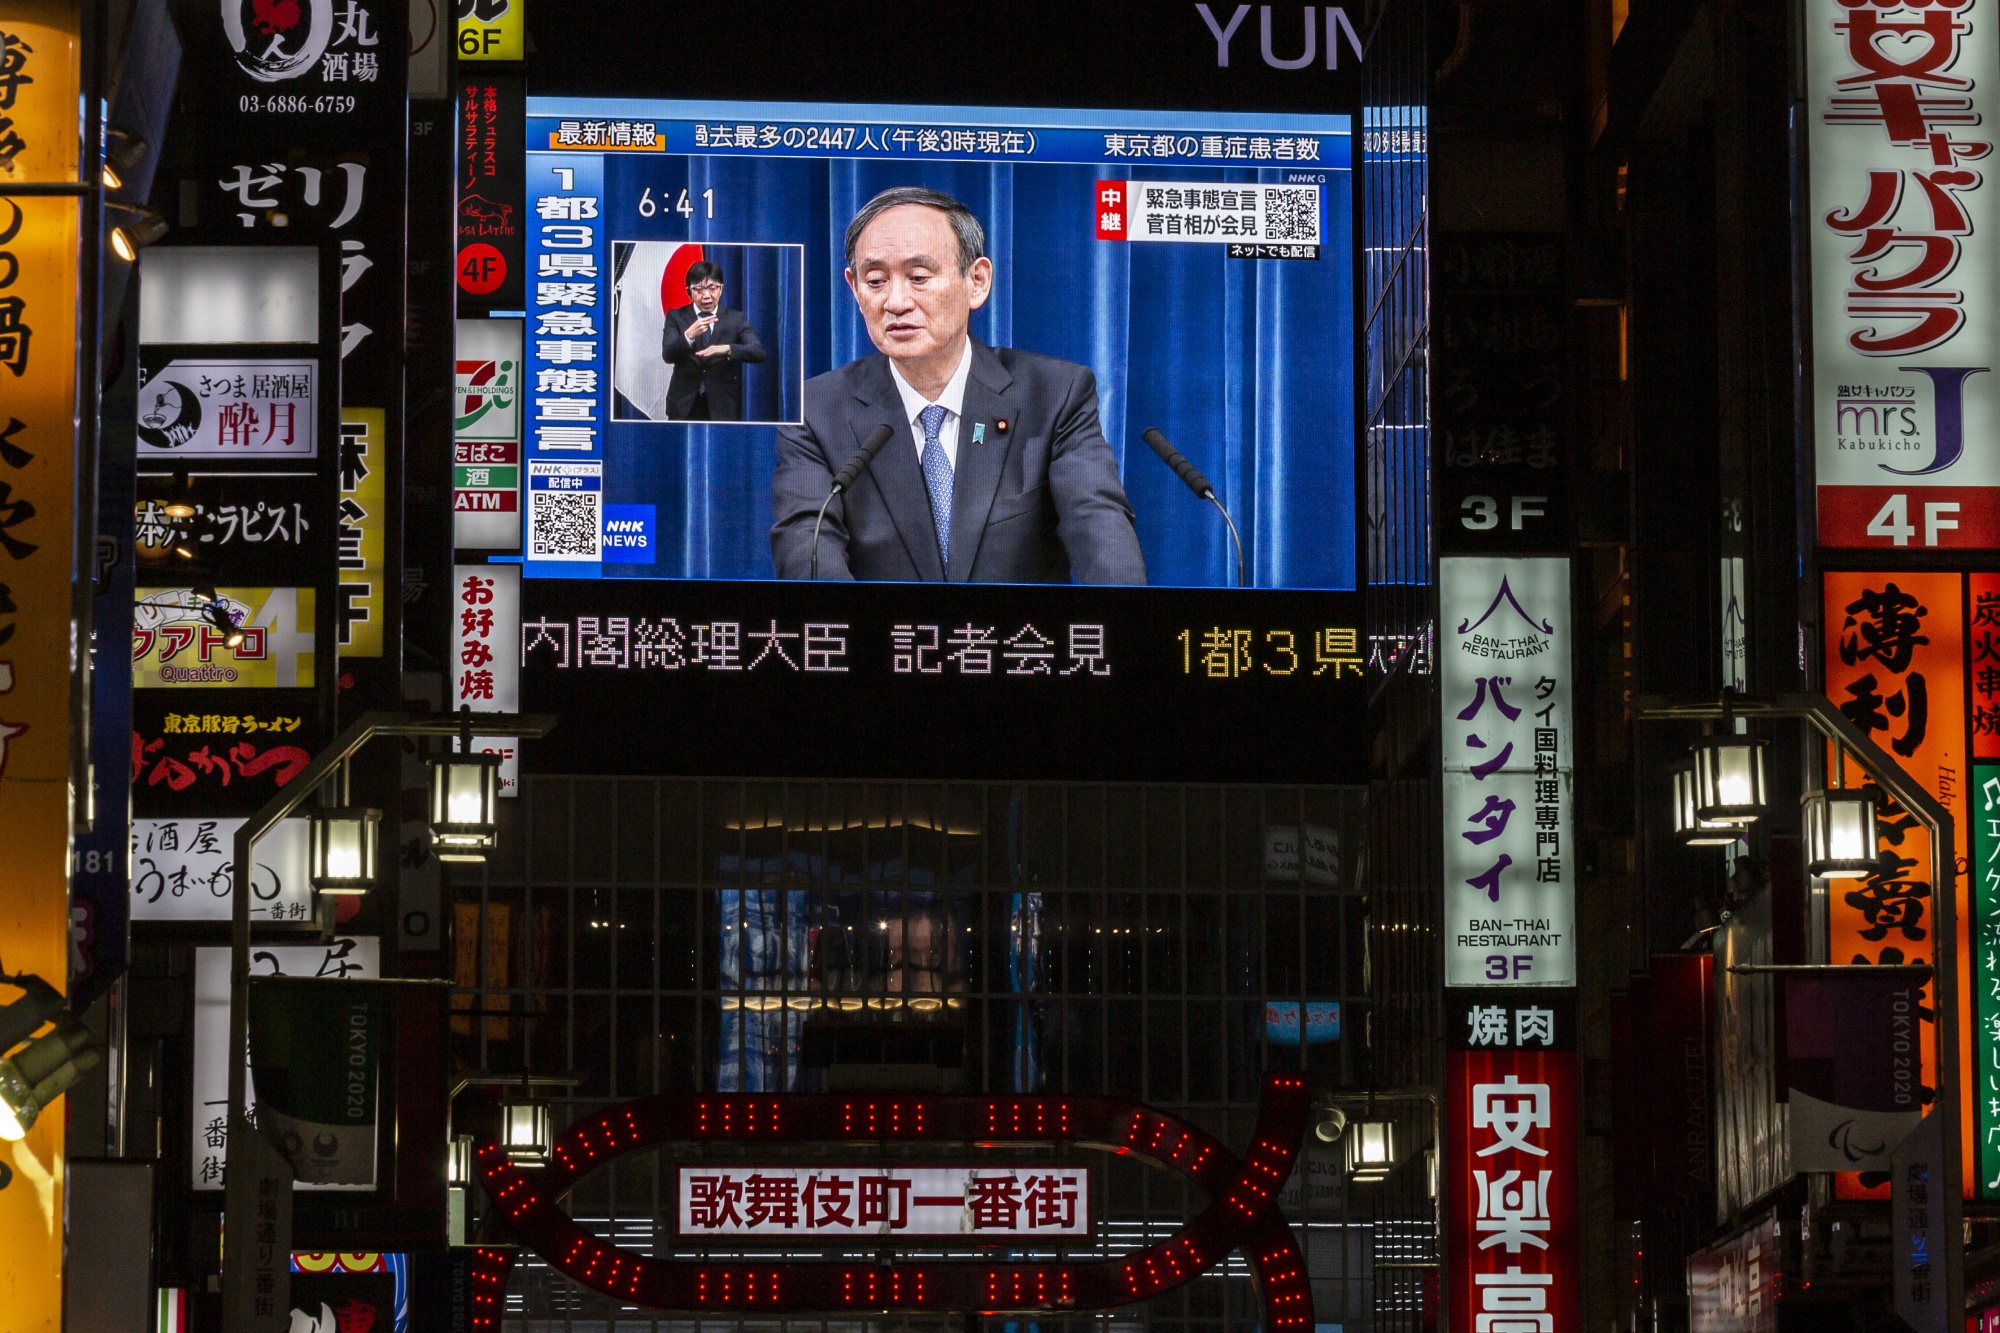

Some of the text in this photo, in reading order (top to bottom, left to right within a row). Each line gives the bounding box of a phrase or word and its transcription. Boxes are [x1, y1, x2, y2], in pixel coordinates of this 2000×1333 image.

[459, 29, 501, 55] 6F
[322, 52, 379, 82] 酒場
[239, 95, 356, 114] 03-6886-6759
[465, 86, 479, 189] サルサラティーノ
[484, 86, 497, 176] 本格シュラスコ
[558, 121, 656, 147] 最新情報
[1104, 133, 1320, 161] 東京都の重症患者数
[1288, 174, 1326, 184] NHK G
[1823, 0, 1993, 357] 女キャバクラ
[639, 187, 714, 219] 6:41
[1101, 188, 1122, 232] 中継
[1146, 188, 1258, 212] 緊急事態宣言
[1146, 214, 1258, 236] 菅首相が会見
[1231, 244, 1316, 259] ネットでも配信
[462, 257, 497, 283] 4F
[535, 167, 599, 451] 1都3県緊急事態宣言
[199, 374, 309, 400] さつま 居酒屋
[477, 386, 514, 395] HOLDINGS
[218, 401, 296, 447] 酔月
[1837, 400, 1920, 436] mrs.
[455, 444, 506, 462] たばこ
[1838, 439, 1921, 450] Kabukicho
[466, 468, 490, 486] 酒
[548, 477, 583, 489] 配信中
[455, 493, 500, 510] ATM
[1461, 495, 1548, 530] 3F
[606, 520, 644, 532] NHK
[1867, 494, 1960, 546] 4F
[602, 535, 647, 548] NEWS
[460, 576, 494, 700] お好み焼
[522, 617, 849, 672] 内閣総理大臣
[891, 622, 1110, 676] 記者会見
[1177, 626, 1364, 679] 1都3県
[1461, 640, 1550, 660] RESTAURANT
[1472, 634, 1539, 649] BAN-THAI
[160, 664, 238, 684] Quattro
[163, 712, 302, 734] 東京豚骨ラーメン
[1457, 676, 1522, 902] バンタイ
[1534, 676, 1561, 883] タイ国料理専門店
[250, 901, 307, 920] 一番街
[1469, 919, 1550, 931] BAN-THAI
[1457, 934, 1562, 947] RESTAURANT
[1485, 955, 1533, 980] 3F
[1468, 1005, 1554, 1047] 焼肉
[1893, 988, 1912, 1105] TOKYO 2020
[346, 1003, 368, 1119] TOKYO 2020
[689, 1173, 1078, 1230] 歌舞伎町一番街
